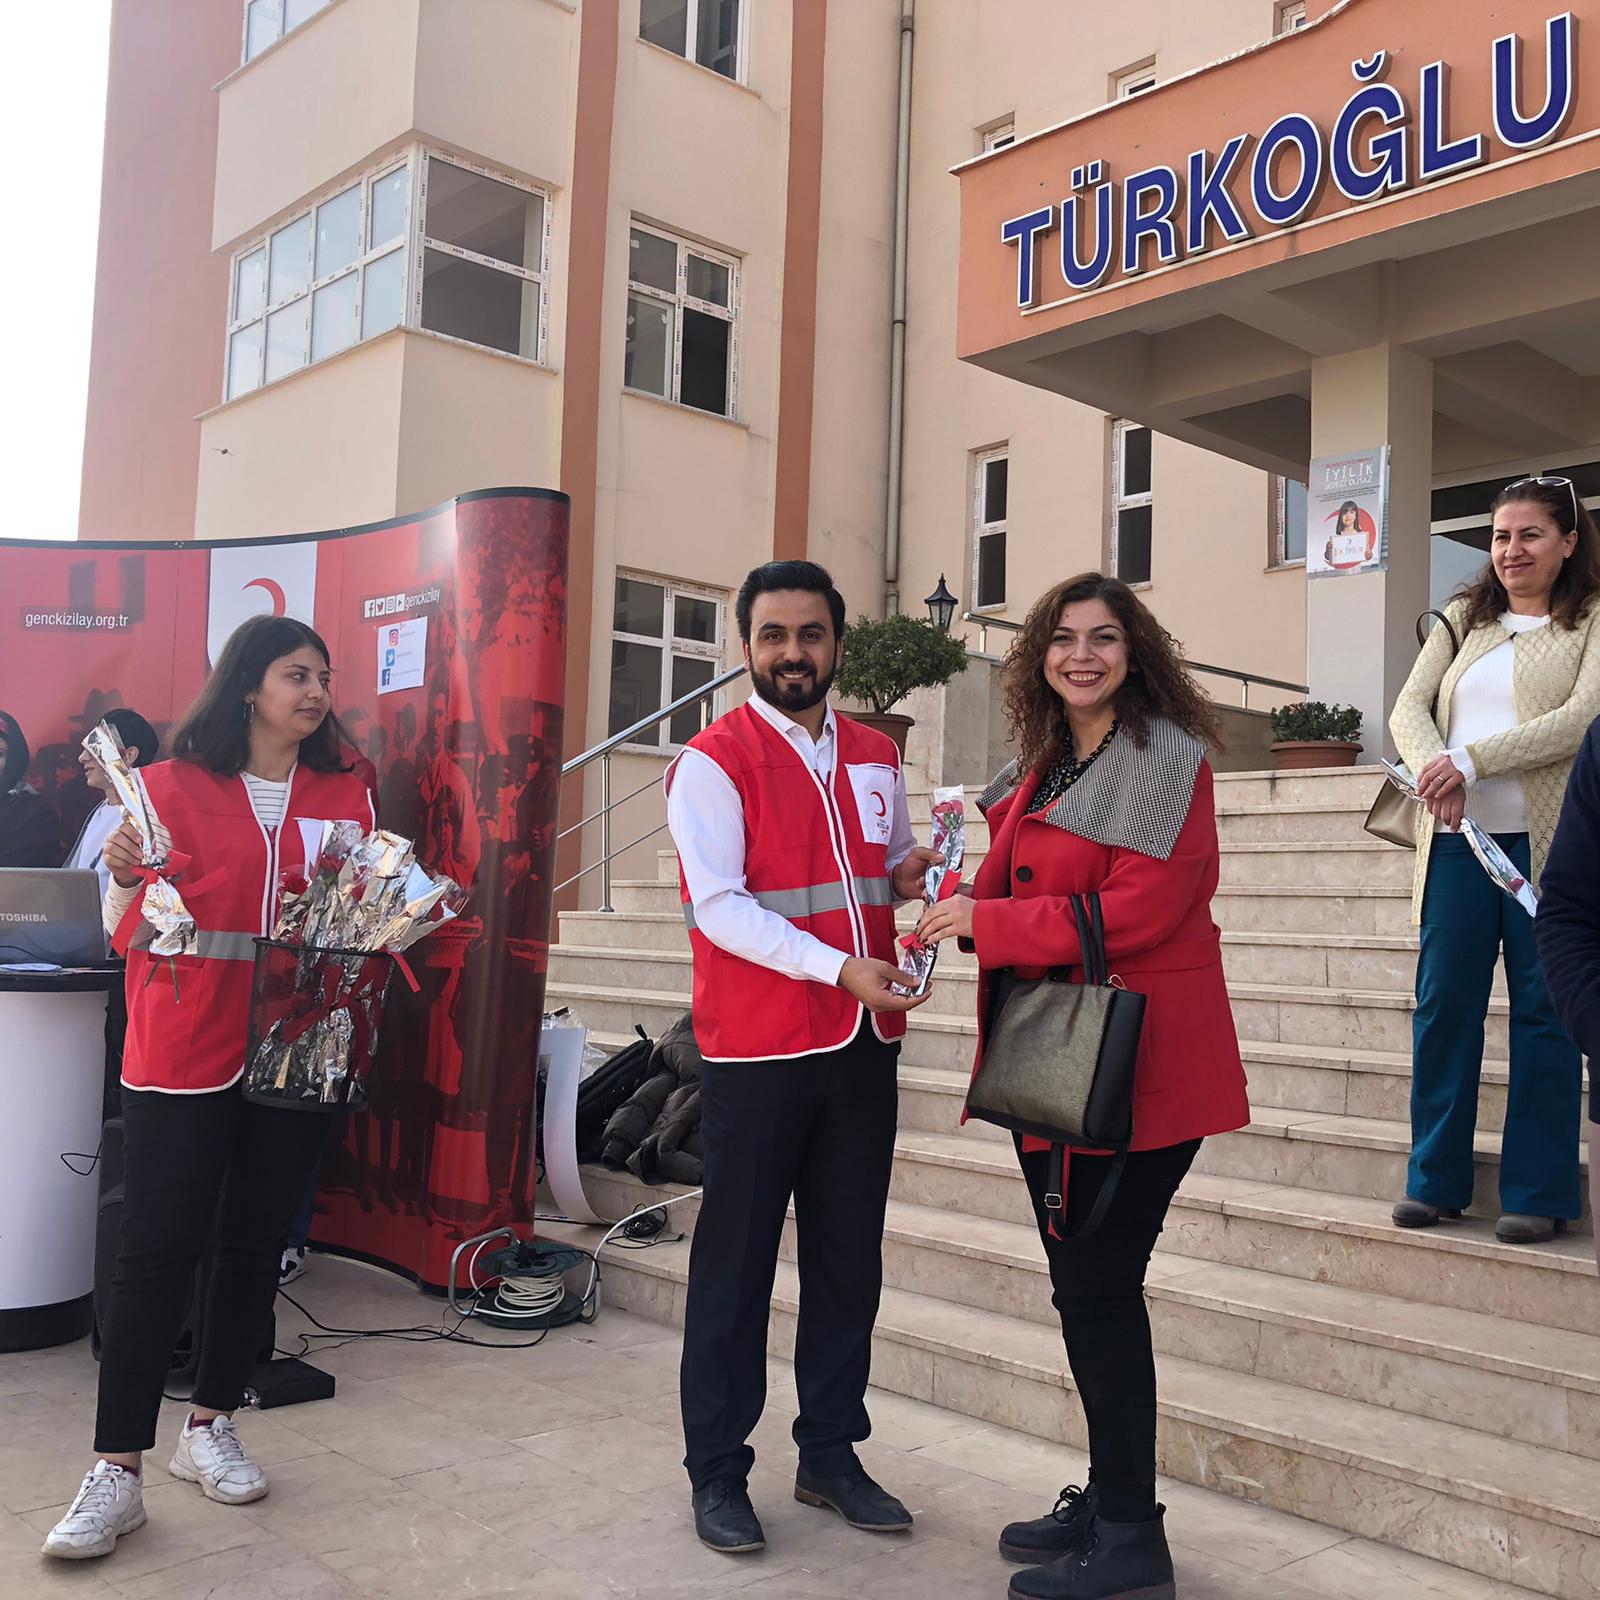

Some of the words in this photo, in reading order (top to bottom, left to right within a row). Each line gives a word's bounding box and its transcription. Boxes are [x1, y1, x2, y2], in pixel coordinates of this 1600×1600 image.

[1001, 11, 1575, 309] TÜRKOĞLU
[25, 612, 129, 629] genckizilay.org.tr
[0, 912, 48, 922] TOSHIBA
